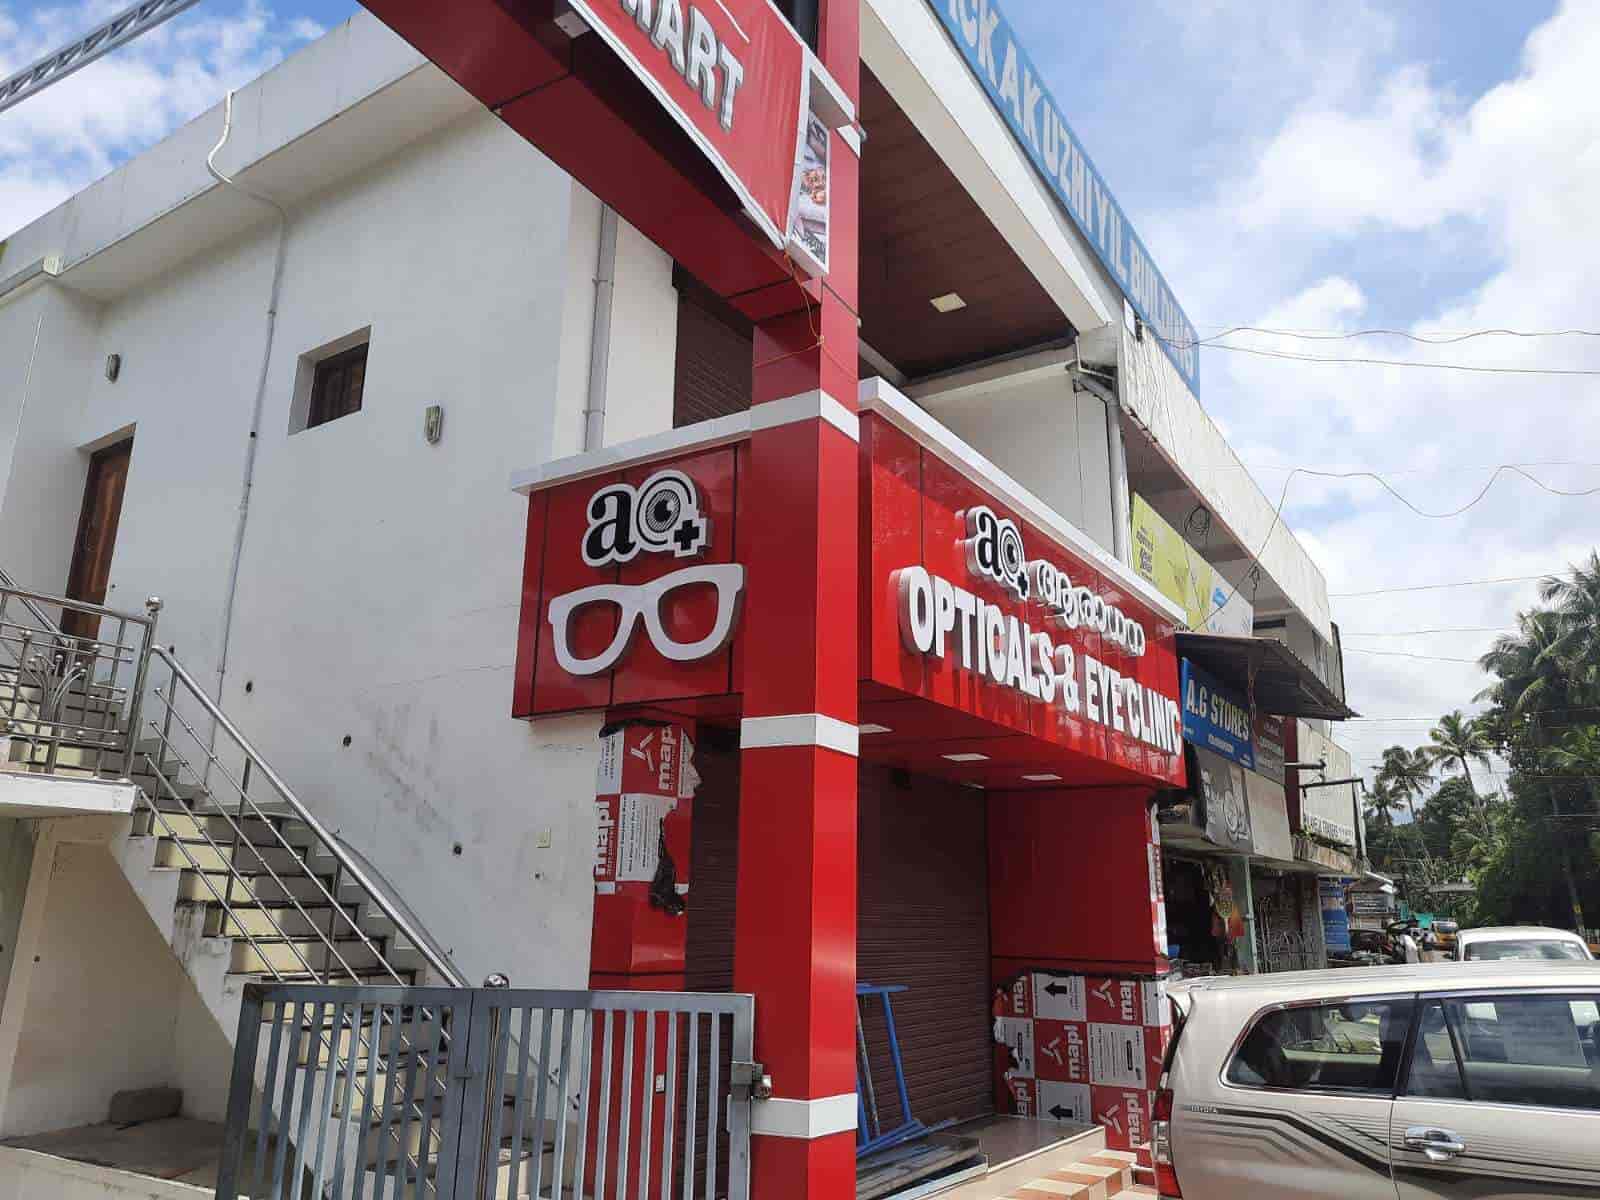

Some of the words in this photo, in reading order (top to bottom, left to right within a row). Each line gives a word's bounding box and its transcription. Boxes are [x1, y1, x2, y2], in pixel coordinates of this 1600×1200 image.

[903, 565, 1056, 703] OPTICALS
[1055, 644, 1080, 713] &
[1085, 654, 1124, 732] EYE
[1121, 676, 1181, 757] CLINIC
[1211, 693, 1249, 741] STORES
